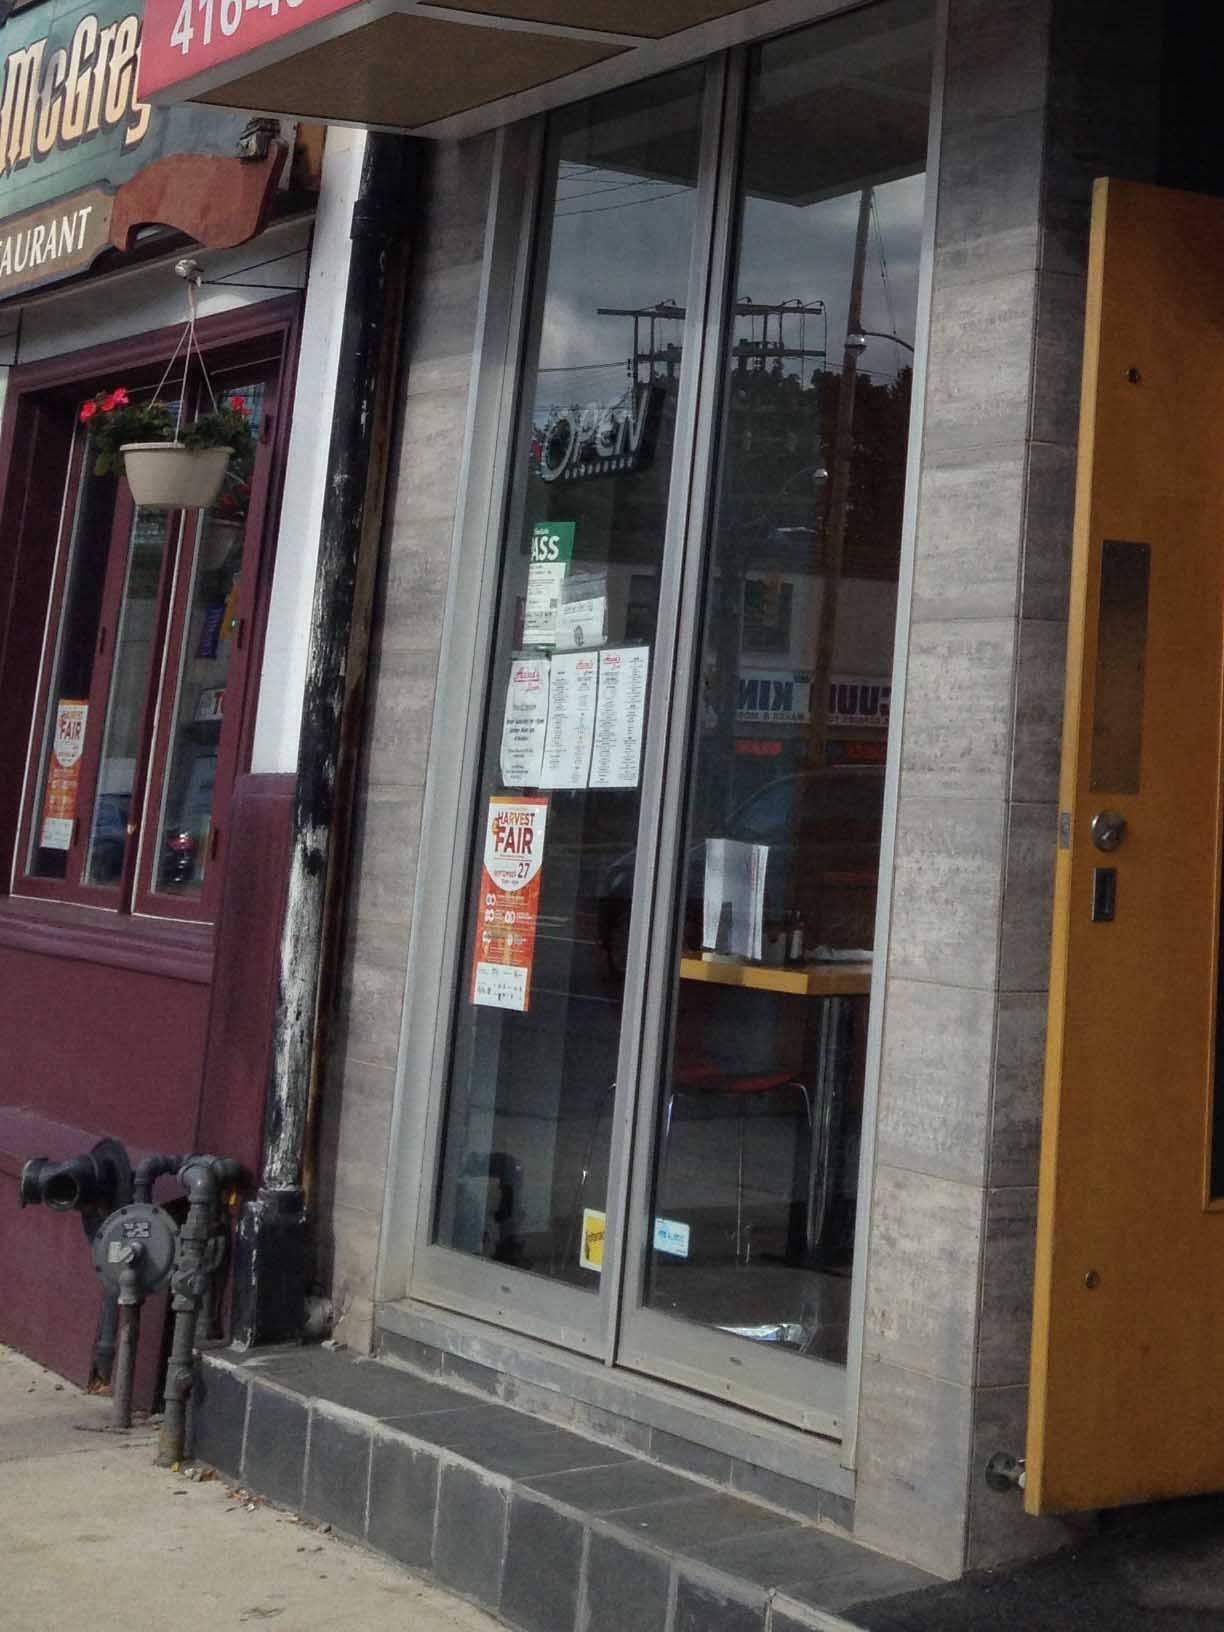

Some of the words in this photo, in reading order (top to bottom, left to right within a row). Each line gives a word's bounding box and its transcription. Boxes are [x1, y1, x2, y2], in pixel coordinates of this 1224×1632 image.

[0, 206, 93, 278] AURANT
[494, 826, 534, 855] FAIR
[517, 863, 531, 879] 27
